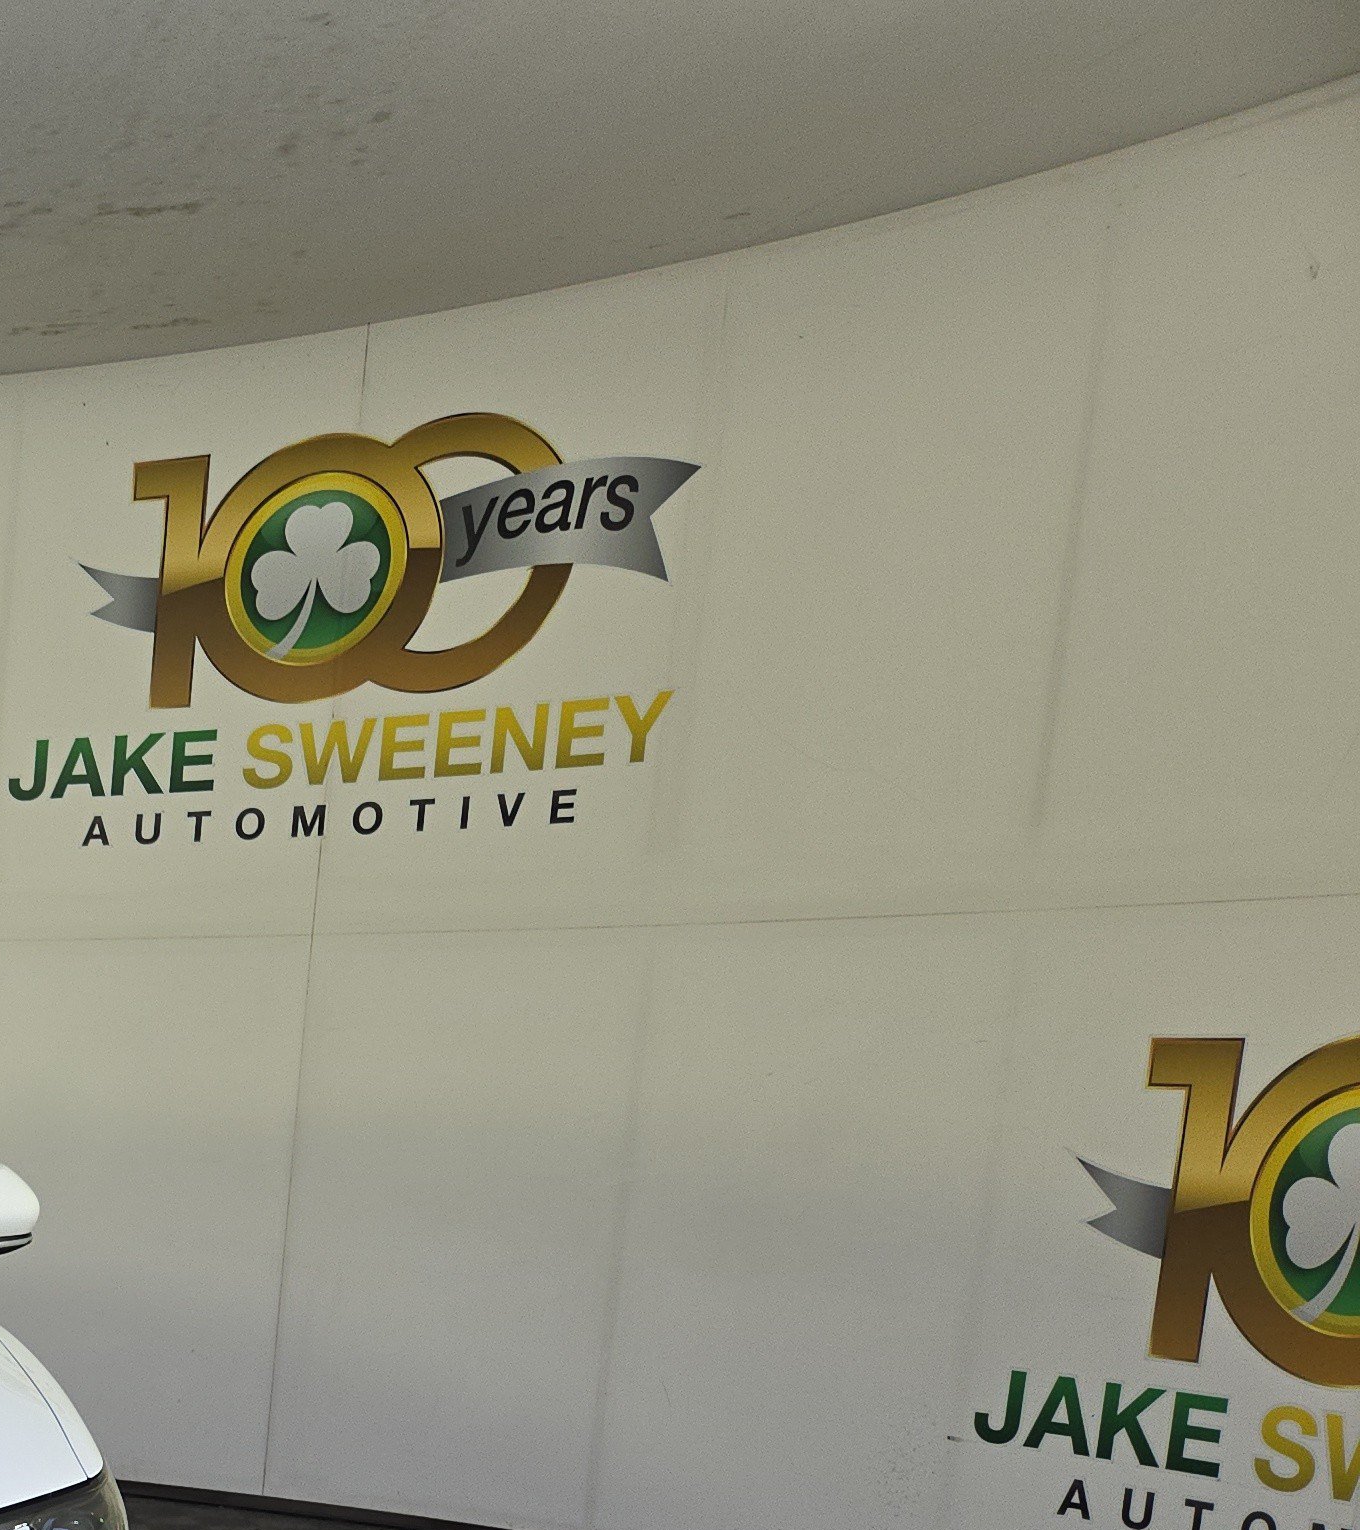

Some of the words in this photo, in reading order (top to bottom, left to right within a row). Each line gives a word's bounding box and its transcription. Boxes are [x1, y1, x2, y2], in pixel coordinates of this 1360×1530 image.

[455, 472, 639, 567] years
[8, 729, 218, 801] JAKE
[241, 690, 674, 789] SWEENEY
[81, 789, 578, 847] AUTOMOTIVE
[974, 1370, 1229, 1478] JAKE
